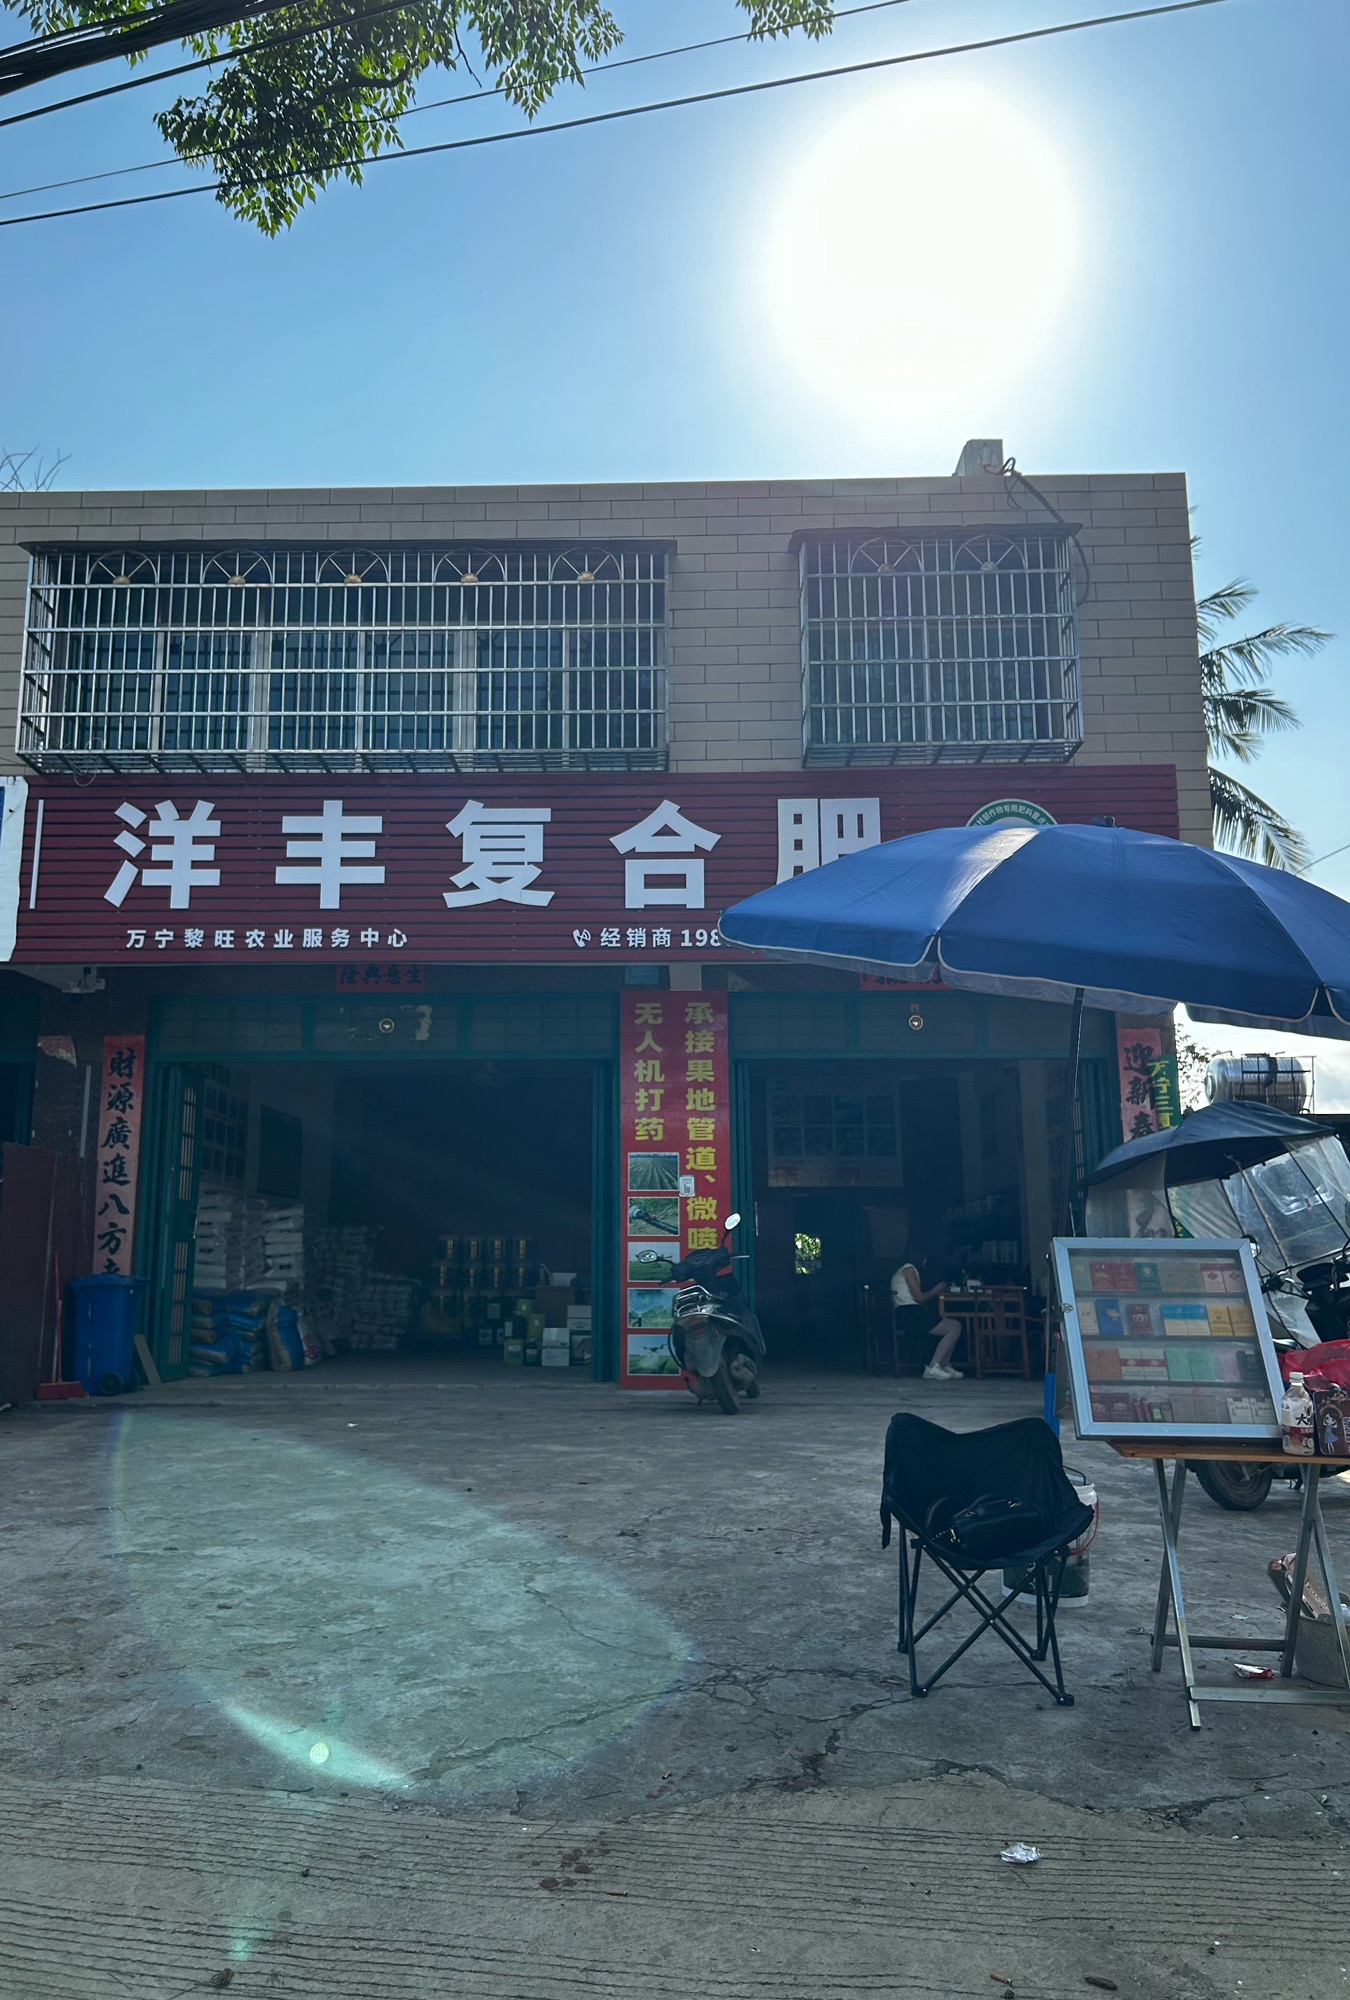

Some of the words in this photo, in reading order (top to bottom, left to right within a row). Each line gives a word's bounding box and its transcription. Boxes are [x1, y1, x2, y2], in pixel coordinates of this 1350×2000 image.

[104, 798, 882, 909] 洋丰复合肥
[125, 928, 408, 949] 万宁黎旺农业服务中心
[600, 927, 672, 948] 经销商
[634, 1002, 665, 1141] 无人机打药
[684, 1002, 718, 1250] 承接果地管道、微喷
